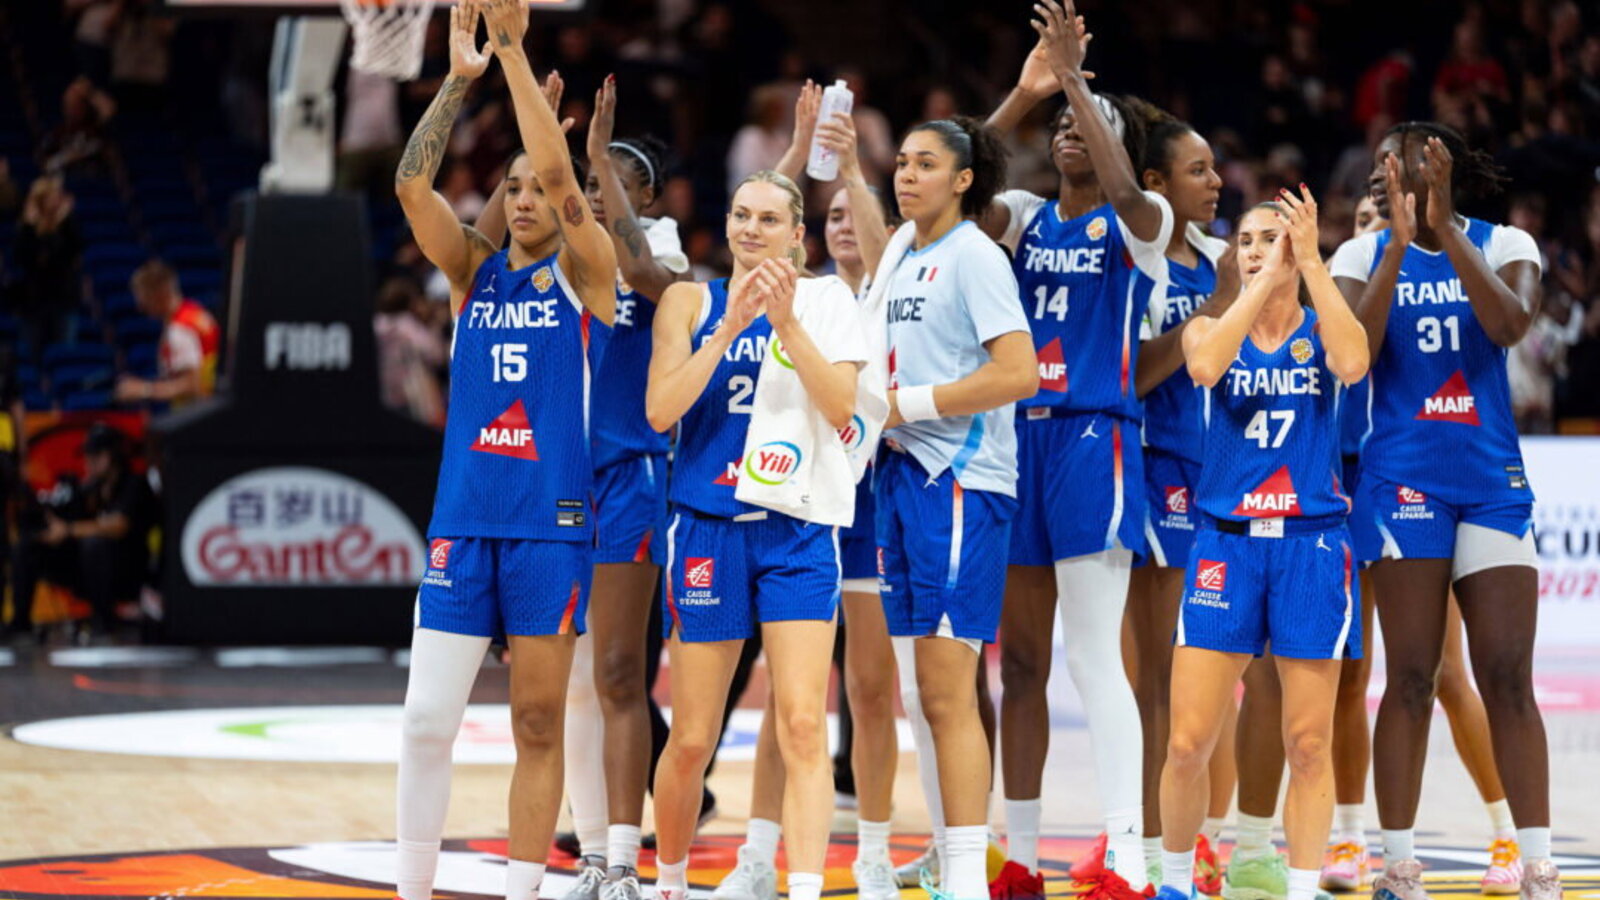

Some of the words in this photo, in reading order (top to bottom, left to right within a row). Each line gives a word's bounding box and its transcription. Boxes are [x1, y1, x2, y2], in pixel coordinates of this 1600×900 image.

[1034, 285, 1069, 322] 14
[1396, 278, 1470, 307] RANC
[468, 299, 560, 329] FRANCE
[264, 321, 352, 371] FIBA
[1416, 315, 1461, 353] 31
[490, 343, 528, 382] 15
[1038, 363, 1067, 380] AIF
[1224, 367, 1322, 396] RANCE
[1424, 396, 1475, 415] MAIF
[480, 427, 534, 447] MAIF
[1244, 409, 1296, 448] 47
[759, 450, 793, 474] Yili
[227, 487, 364, 527] 百岁山
[1242, 492, 1298, 512] MAIF
[1537, 525, 1600, 560] CU
[1539, 568, 1600, 599] 202
